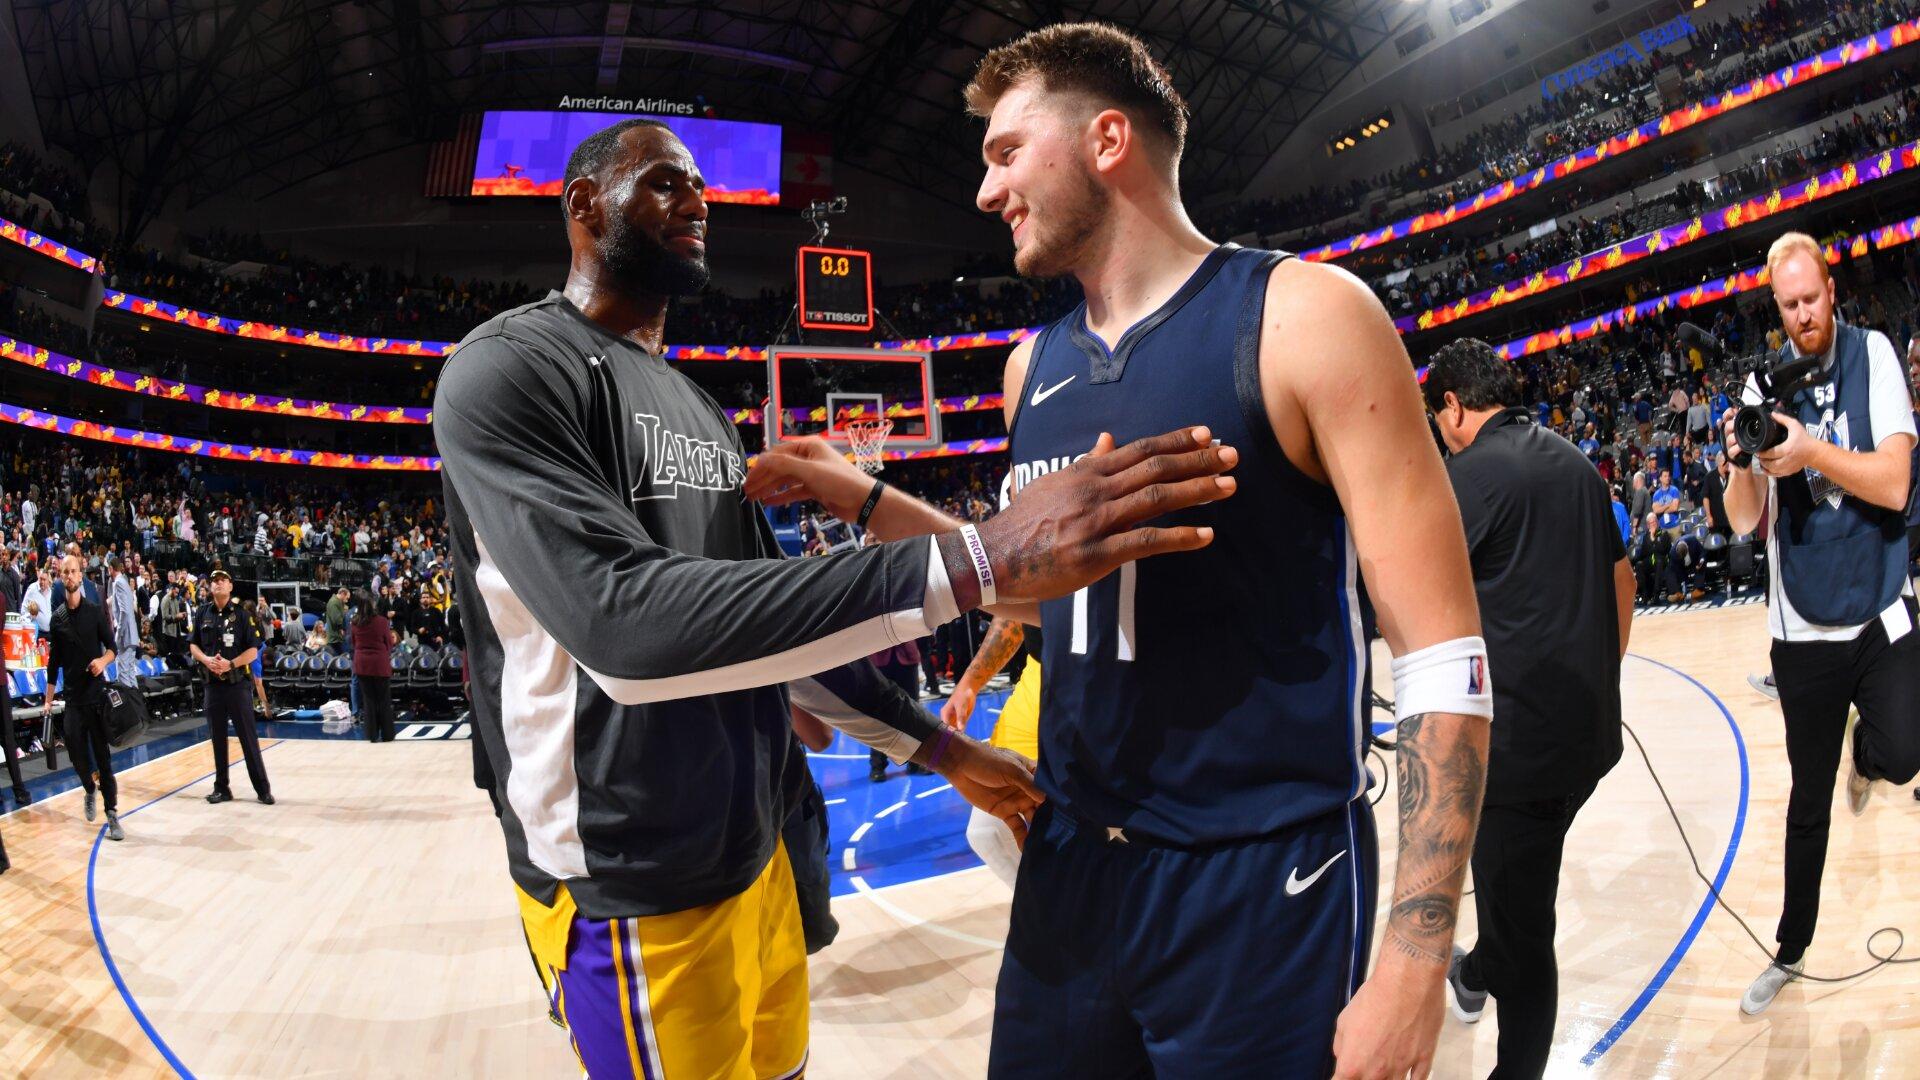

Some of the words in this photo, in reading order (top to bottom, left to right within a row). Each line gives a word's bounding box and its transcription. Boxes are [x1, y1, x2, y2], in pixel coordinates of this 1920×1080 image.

[1638, 14, 1697, 53] Bank
[558, 94, 633, 111] American
[634, 97, 694, 115] Airlines
[821, 256, 849, 276] 0.0
[823, 312, 868, 323] TISSOT
[1814, 382, 1836, 407] 53
[631, 413, 747, 501] LAKERS
[967, 534, 992, 588] PROMISE
